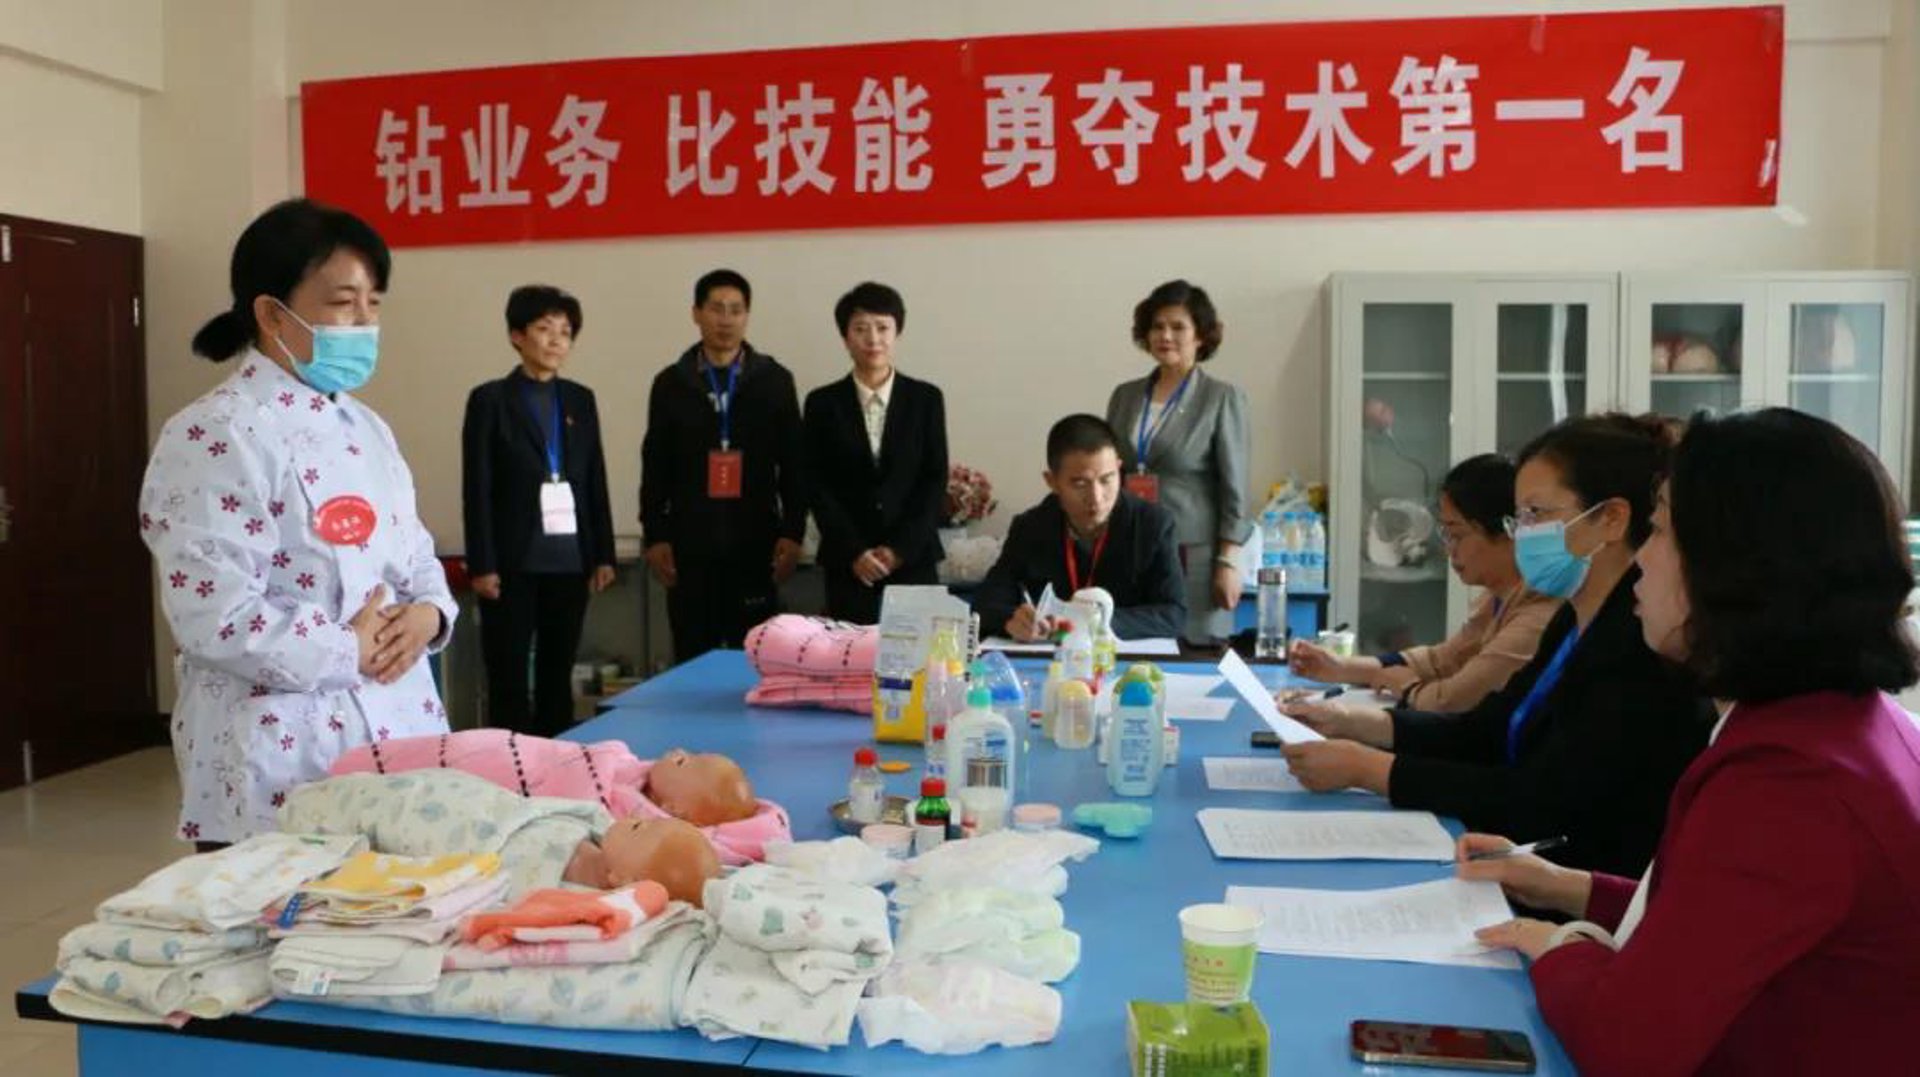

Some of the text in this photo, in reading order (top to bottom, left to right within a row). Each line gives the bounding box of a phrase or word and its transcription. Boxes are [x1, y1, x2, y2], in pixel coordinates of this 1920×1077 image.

[375, 47, 1687, 215] 钻业务 比技能 勇夺技术第一名
